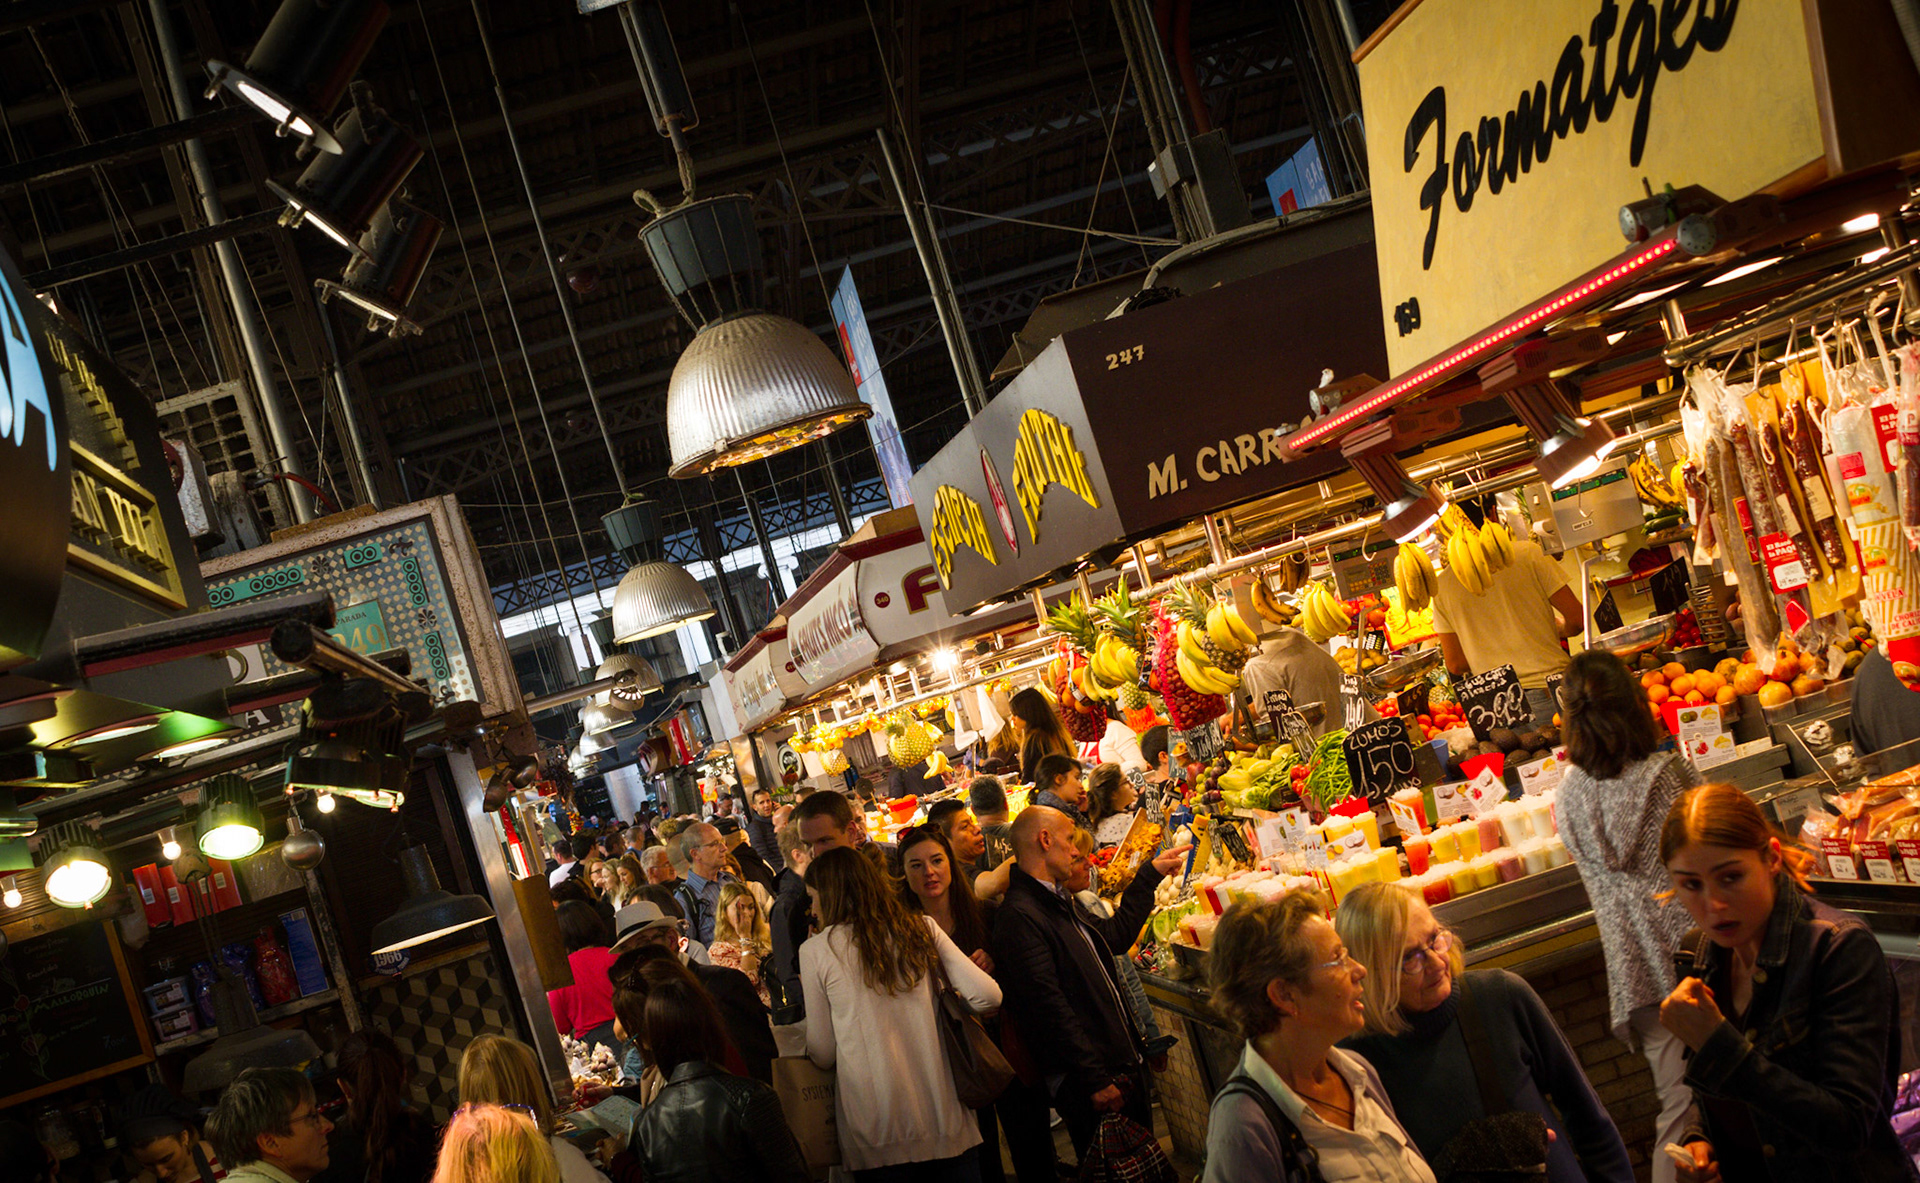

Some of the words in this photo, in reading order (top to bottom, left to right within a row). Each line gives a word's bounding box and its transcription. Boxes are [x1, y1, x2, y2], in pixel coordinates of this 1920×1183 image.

[1404, 0, 1738, 270] Formatges
[1394, 296, 1421, 338] 169
[1105, 344, 1145, 371] 247
[1012, 408, 1101, 546] FRUTAL
[1147, 453, 1189, 500] M.
[1195, 424, 1300, 482] CARR
[930, 484, 1000, 591] ESENCIA
[335, 612, 367, 626] PARADA
[797, 613, 831, 666] FRUITS
[1347, 722, 1402, 751] ZUMOS
